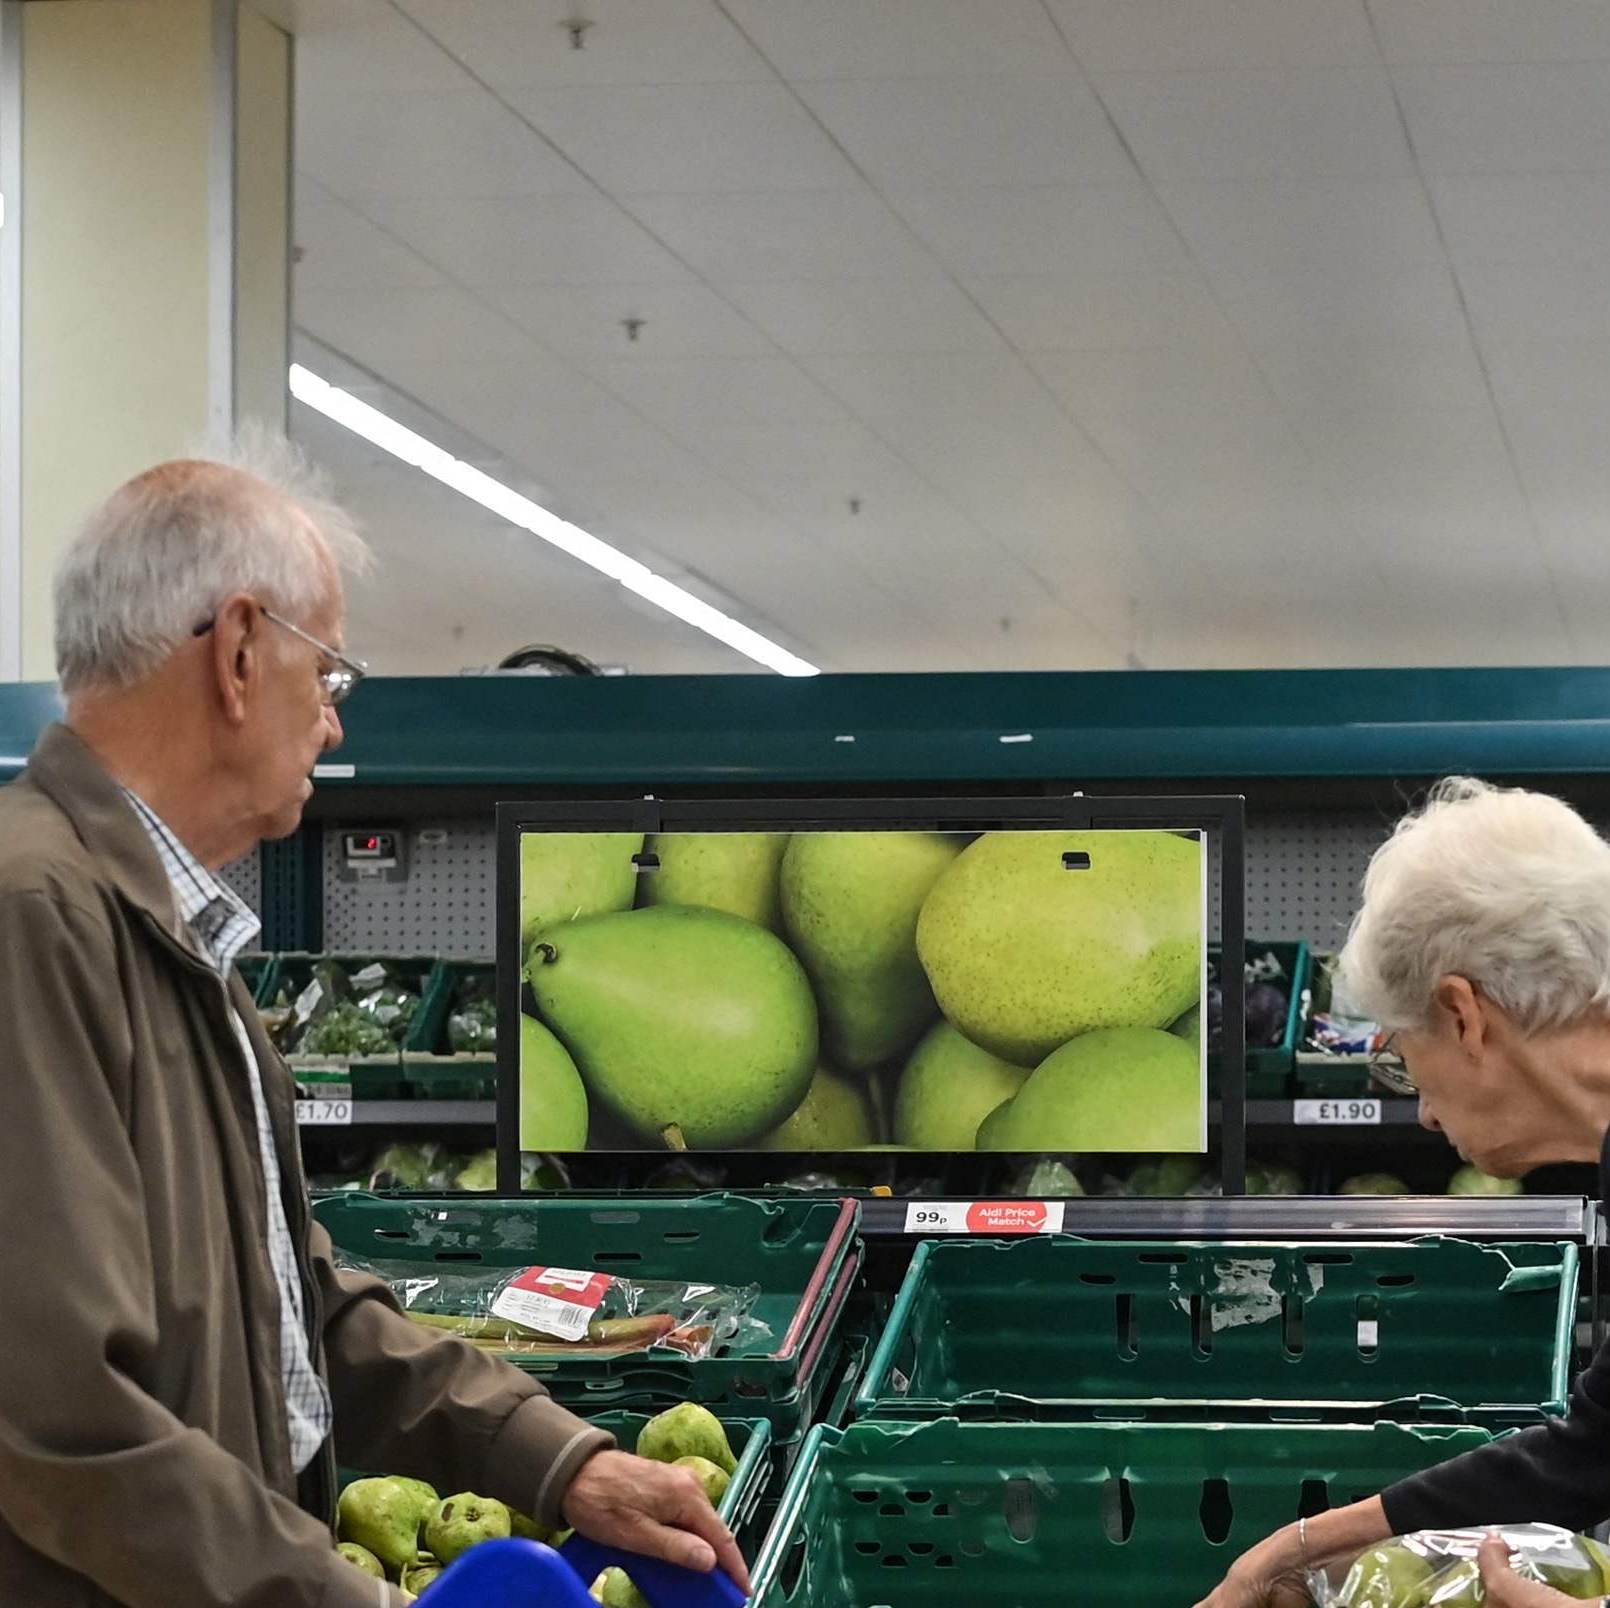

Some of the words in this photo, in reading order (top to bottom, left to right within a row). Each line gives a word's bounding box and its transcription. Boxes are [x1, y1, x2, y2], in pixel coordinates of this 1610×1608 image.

[296, 1103, 348, 1119] £1.70
[1319, 1102, 1376, 1119] £1.90
[915, 1211, 948, 1225] 99p
[979, 1208, 1002, 1217] Aldi
[1005, 1208, 1036, 1217] Price
[987, 1218, 1025, 1226] Match
